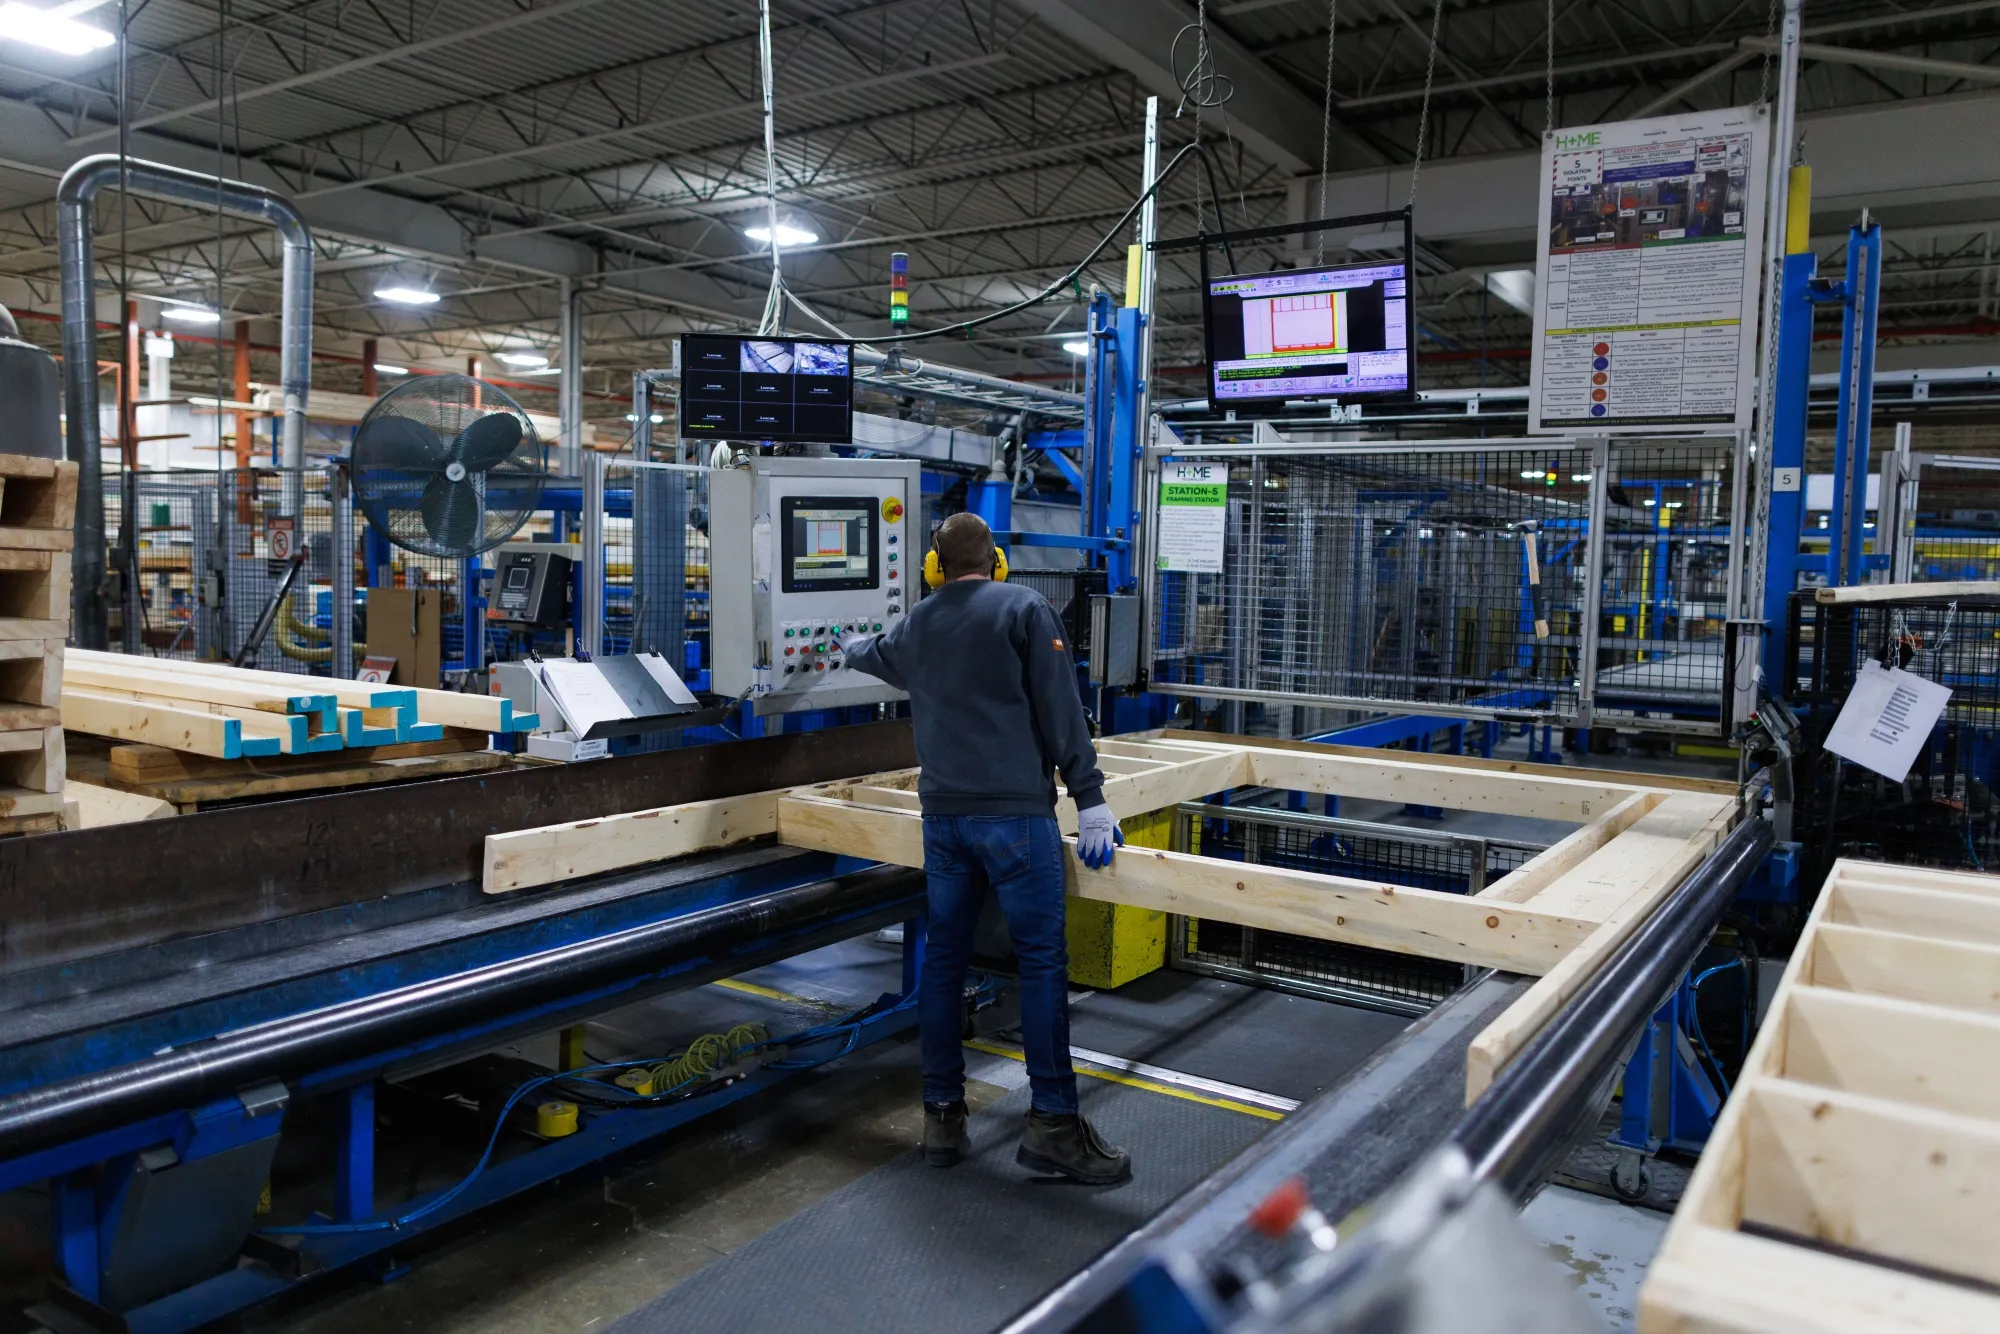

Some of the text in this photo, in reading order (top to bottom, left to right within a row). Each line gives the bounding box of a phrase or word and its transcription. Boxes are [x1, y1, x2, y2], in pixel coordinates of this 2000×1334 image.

[1575, 160, 1580, 168] 5
[1783, 474, 1791, 484] 5
[1168, 487, 1218, 495] STATION-5
